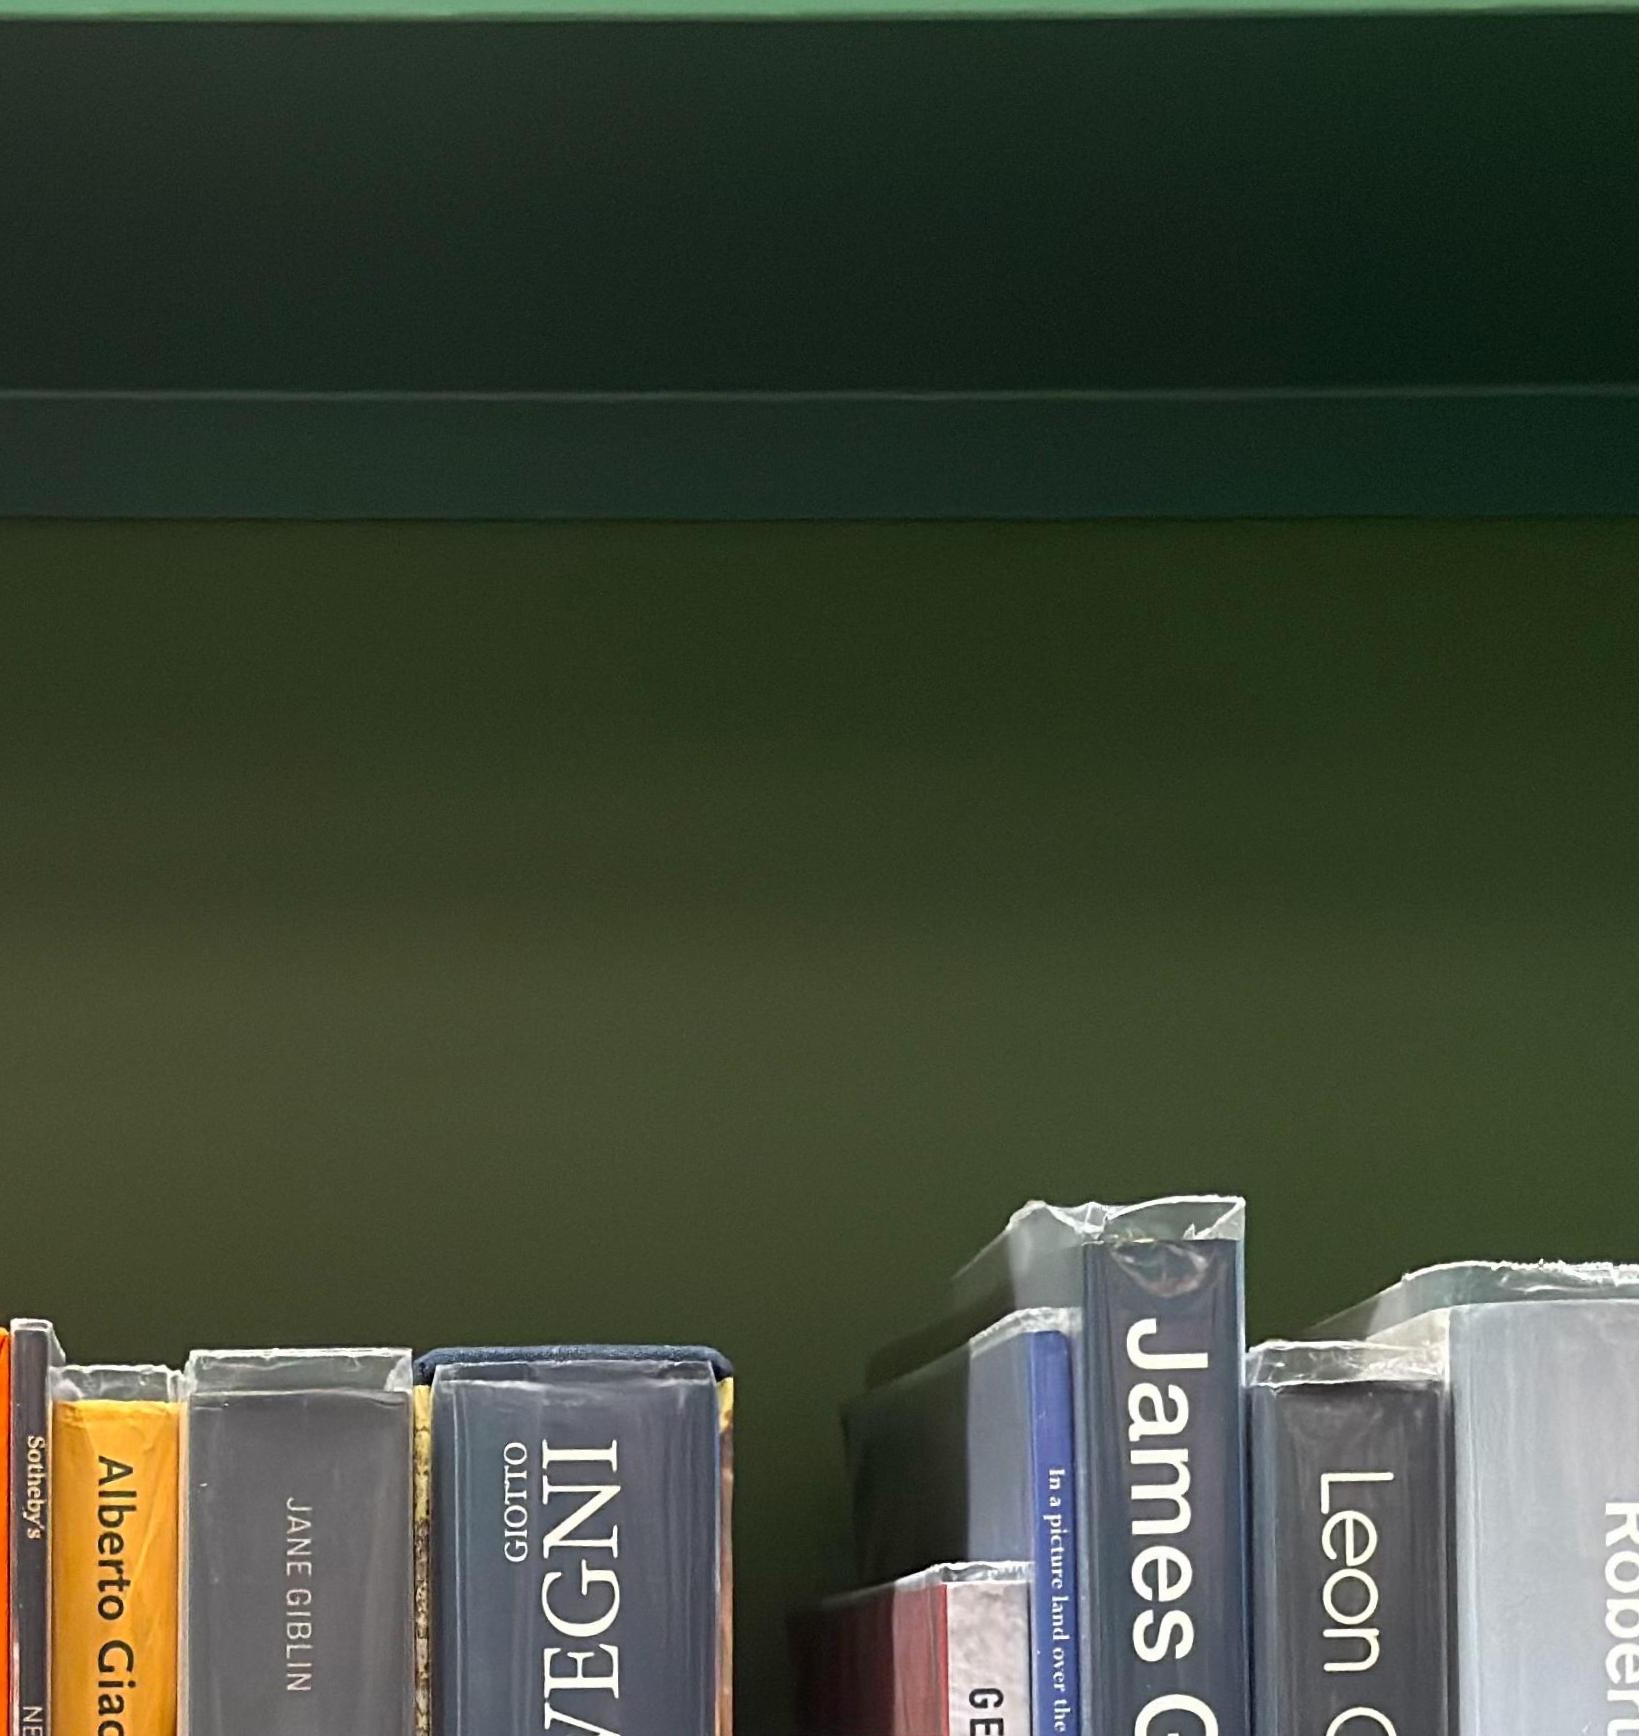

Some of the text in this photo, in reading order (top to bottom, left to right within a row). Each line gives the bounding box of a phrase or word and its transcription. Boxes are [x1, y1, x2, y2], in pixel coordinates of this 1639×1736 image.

[503, 1442, 529, 1562] GIOTTO
[1048, 1468, 1066, 1490] In
[1048, 1496, 1060, 1506] a
[1124, 1318, 1209, 1661] James
[95, 1455, 133, 1620] Alberto
[1044, 1514, 1067, 1588] picture
[1320, 1472, 1397, 1673] Leon
[285, 1497, 312, 1692] JANE GIBLIN
[1049, 1595, 1071, 1640] land
[1050, 1647, 1068, 1692] over
[1052, 1699, 1070, 1733] the
